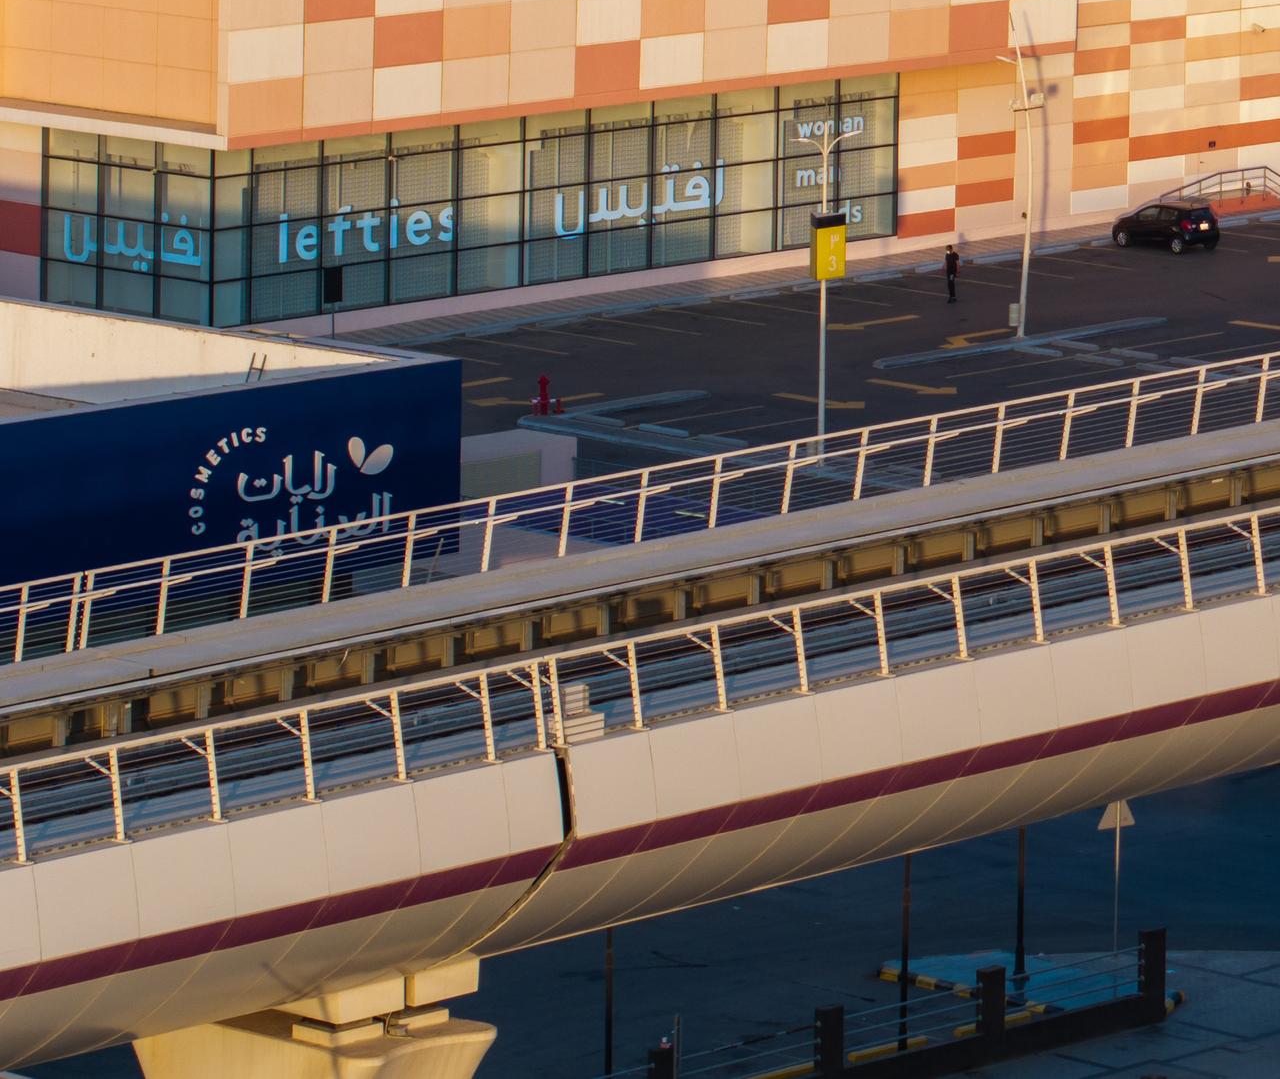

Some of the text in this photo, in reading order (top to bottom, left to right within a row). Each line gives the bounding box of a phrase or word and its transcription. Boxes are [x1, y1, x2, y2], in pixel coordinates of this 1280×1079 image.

[798, 116, 864, 138] woman
[278, 197, 454, 264] lefties
[554, 159, 725, 240] لفتيس
[816, 200, 863, 224] ds
[63, 211, 202, 273] فتيس
[188, 426, 268, 536] COSMETICS
[236, 450, 338, 505] رايات
[236, 491, 394, 558] العناية
